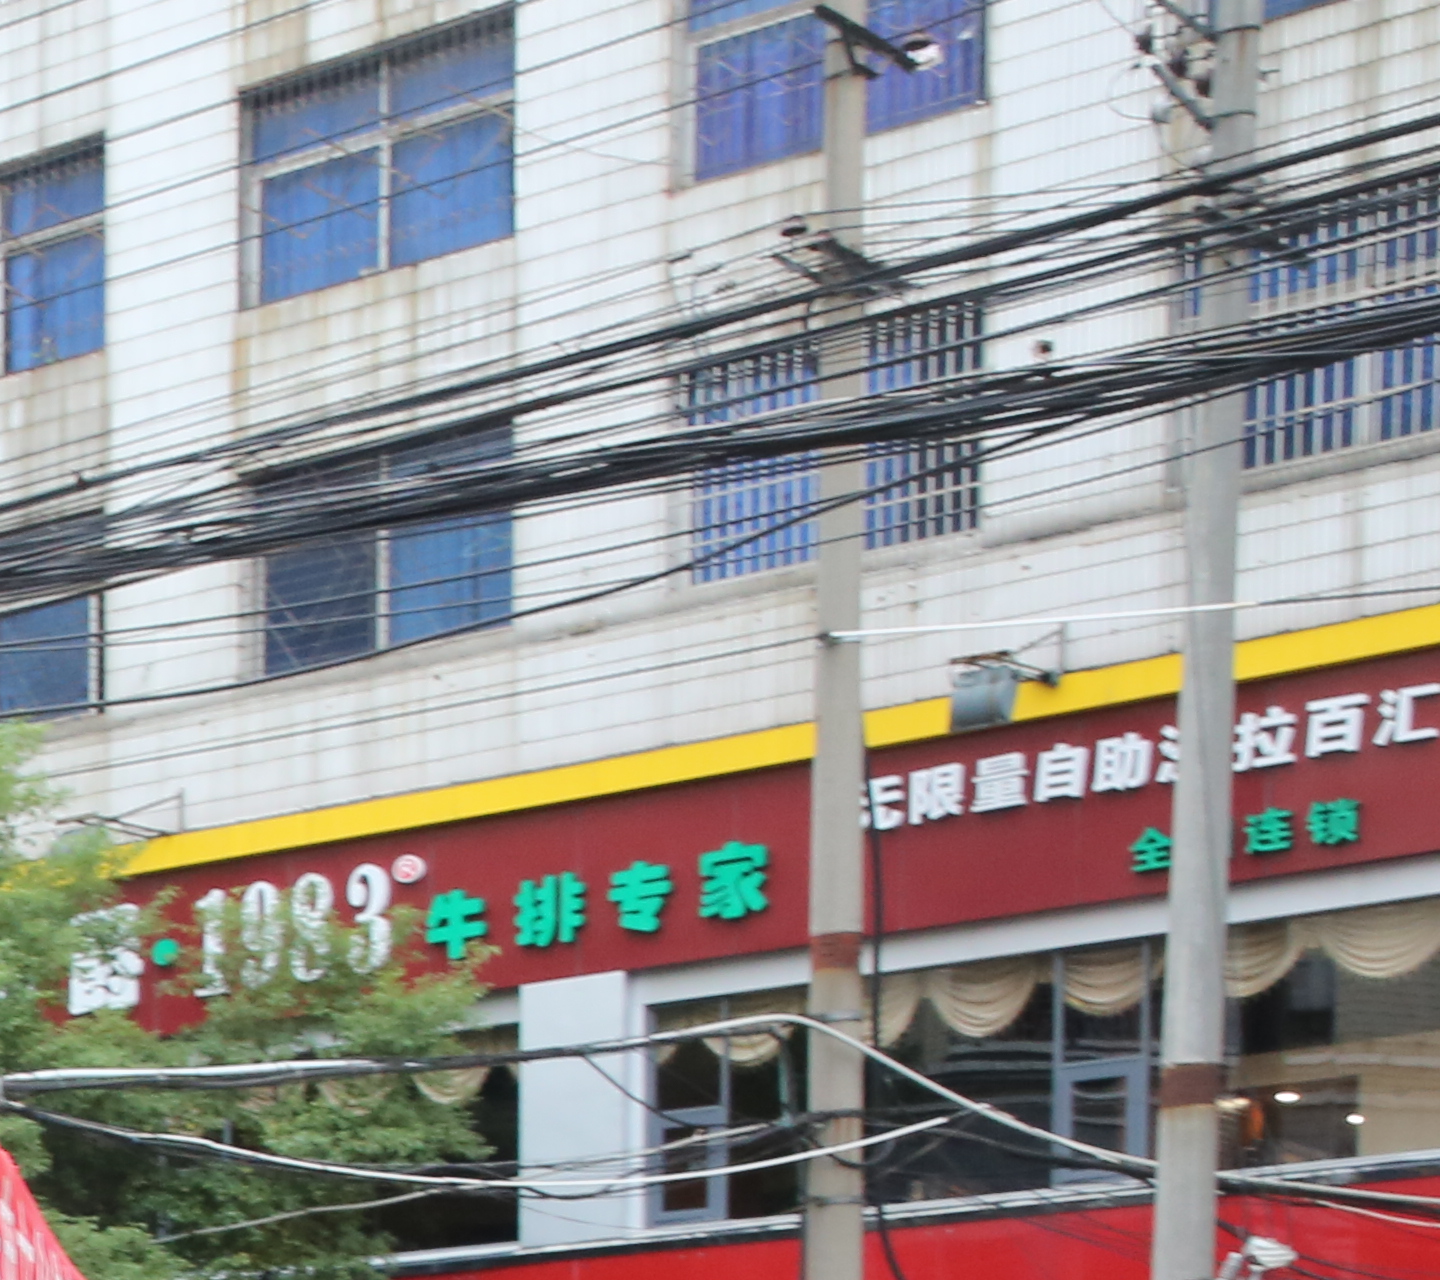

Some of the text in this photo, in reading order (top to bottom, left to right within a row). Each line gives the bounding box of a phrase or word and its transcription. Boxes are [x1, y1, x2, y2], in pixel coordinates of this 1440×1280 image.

[858, 683, 1440, 831] 无限量自助拉百汇
[1130, 798, 1359, 873] 全连锁
[426, 841, 770, 961] 牛排专家
